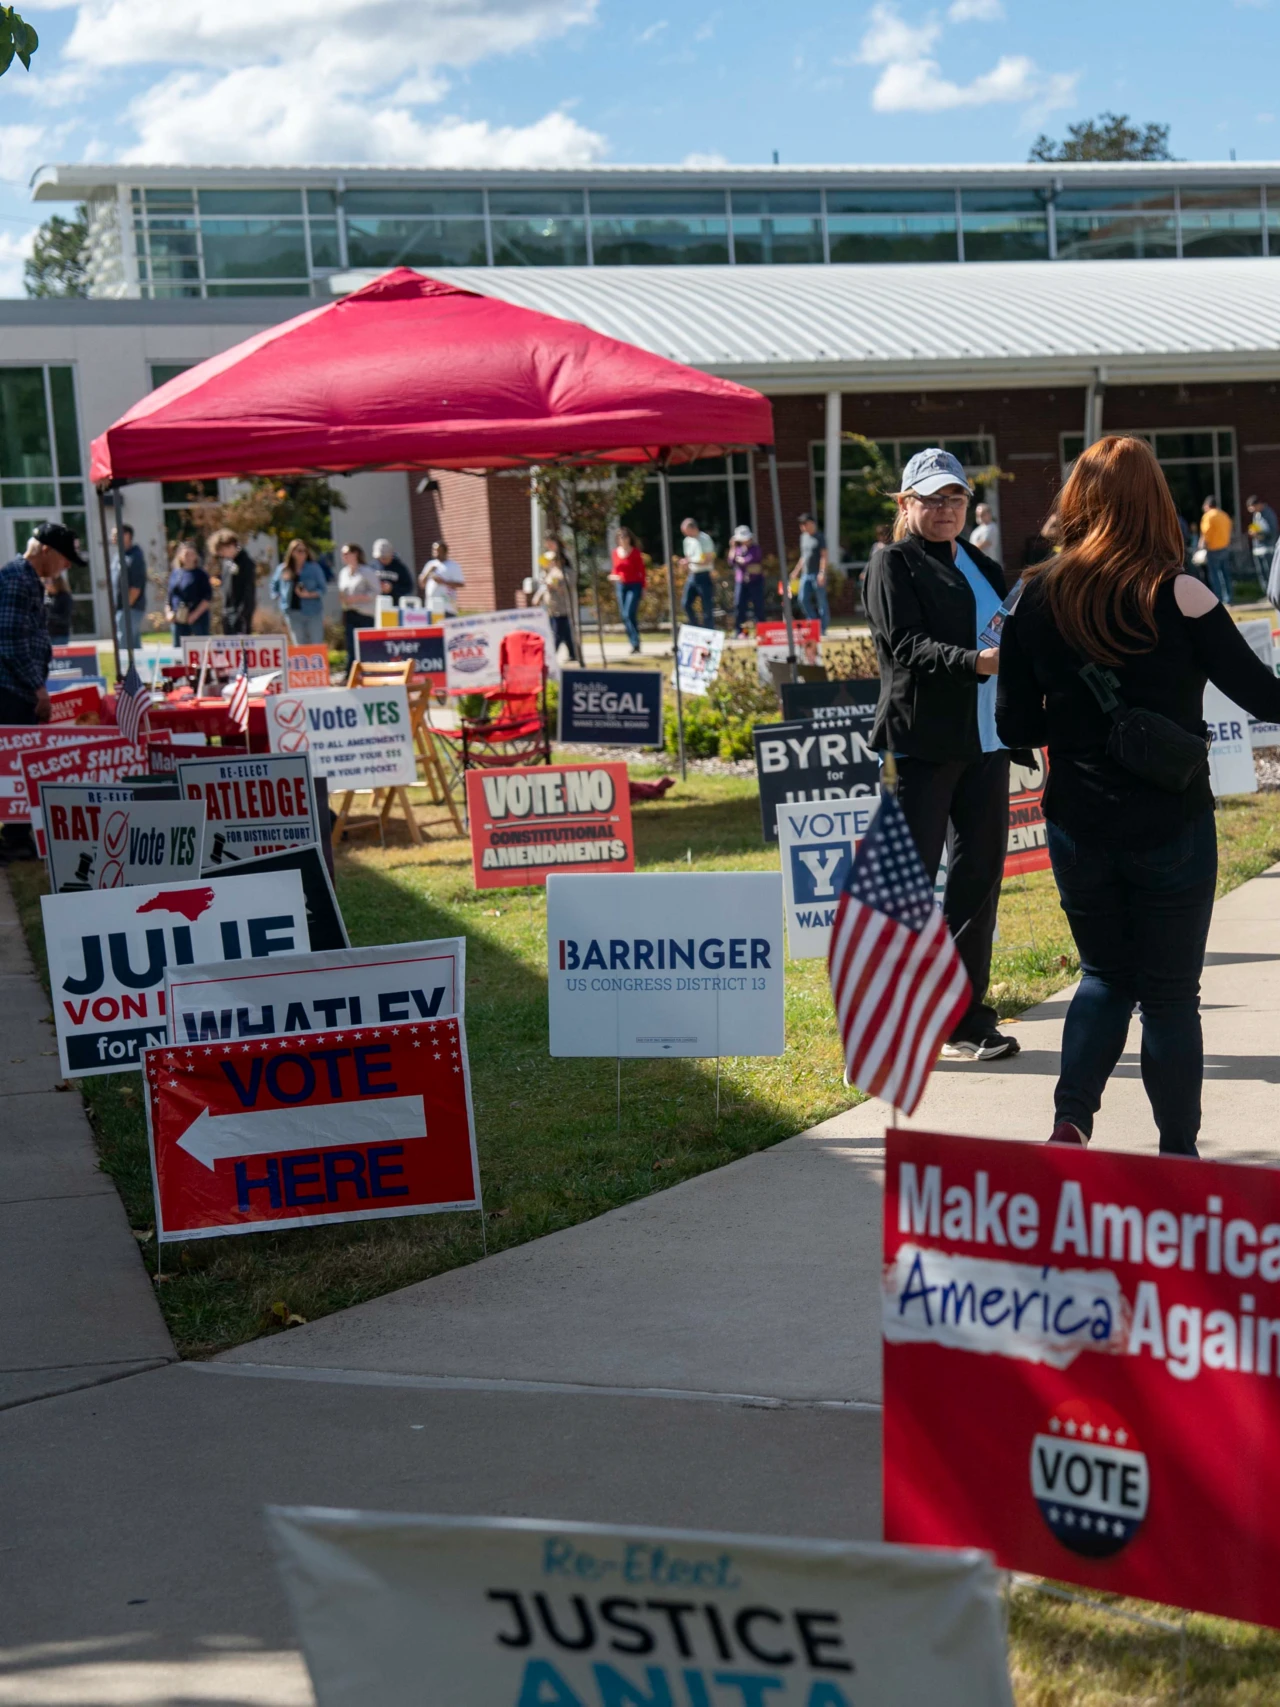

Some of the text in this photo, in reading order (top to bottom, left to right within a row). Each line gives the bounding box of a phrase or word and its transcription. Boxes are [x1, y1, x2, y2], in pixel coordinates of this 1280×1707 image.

[385, 641, 420, 656] Tyler
[308, 701, 400, 731] Vote YES
[572, 692, 650, 714] SEGAL
[313, 734, 405, 750] TO ALL AMENDMENTS
[334, 754, 356, 762] KEEP
[360, 751, 382, 760] YOUR
[760, 731, 879, 773] BYRN
[27, 749, 81, 778] ELECT
[87, 744, 148, 769] SHIRL
[151, 752, 178, 771] Mak
[220, 765, 268, 778] RE-ELECT
[338, 767, 361, 776] YOUR
[364, 764, 397, 775] POCKET
[826, 770, 844, 781] for
[482, 769, 615, 819] VOTE NO
[227, 828, 310, 842] FOR DISTRICT COURT
[490, 825, 615, 845] CONSTITUTIONAL
[788, 810, 869, 839] VOTE
[129, 826, 196, 866] Vote YES
[482, 839, 628, 871] AMENDMENTS
[796, 909, 836, 928] WAK
[559, 938, 772, 970] BARRINGER
[567, 977, 766, 991] US CONGRESS DISTRICT 13
[62, 993, 148, 1025] VON
[97, 1034, 137, 1061] for
[220, 1043, 398, 1107] VOTE
[234, 1146, 409, 1211] HERE
[898, 1162, 1039, 1249] Make
[899, 1252, 1113, 1341] America
[1038, 1448, 1141, 1510] VOTE
[541, 1535, 742, 1590] Re-Elect
[486, 1588, 855, 1674] JUSTICE
